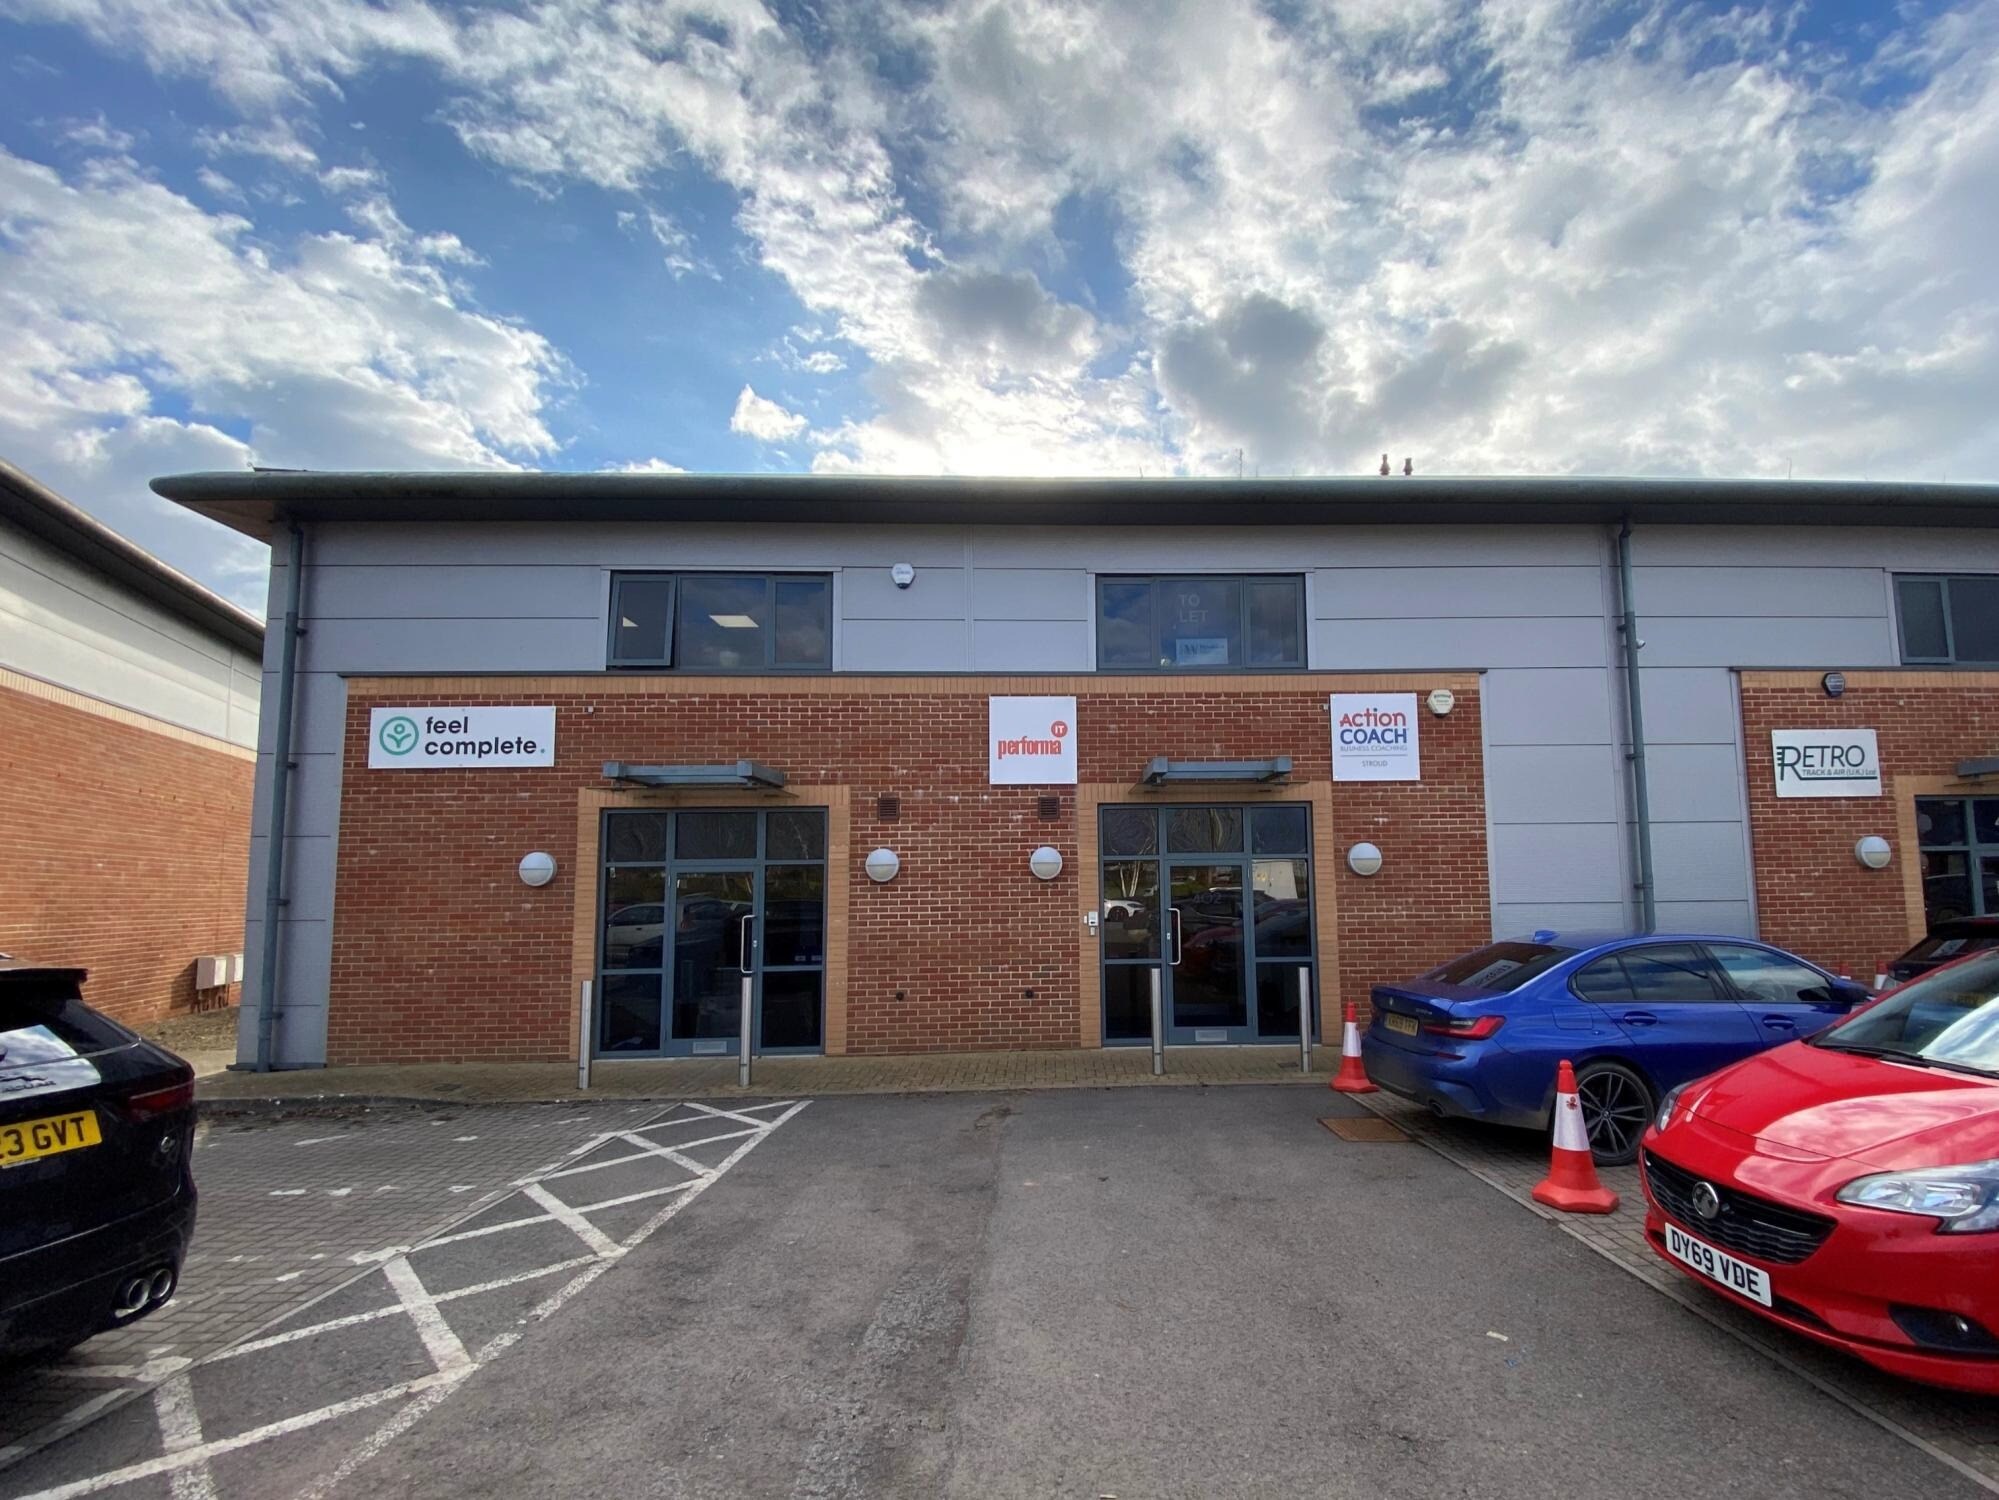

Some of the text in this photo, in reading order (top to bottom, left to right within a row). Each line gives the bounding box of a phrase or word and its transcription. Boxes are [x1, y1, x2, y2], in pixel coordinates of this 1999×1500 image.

[1178, 593, 1200, 607] TO
[1179, 609, 1208, 623] LET
[425, 716, 468, 734] feel
[1340, 728, 1407, 744] COACH
[997, 735, 1062, 760] performa
[1370, 744, 1407, 752] COACHING
[1776, 745, 1865, 781] RETRO
[0, 1116, 85, 1160] 3 GVT
[1671, 1228, 1761, 1297] DY69 VDE
